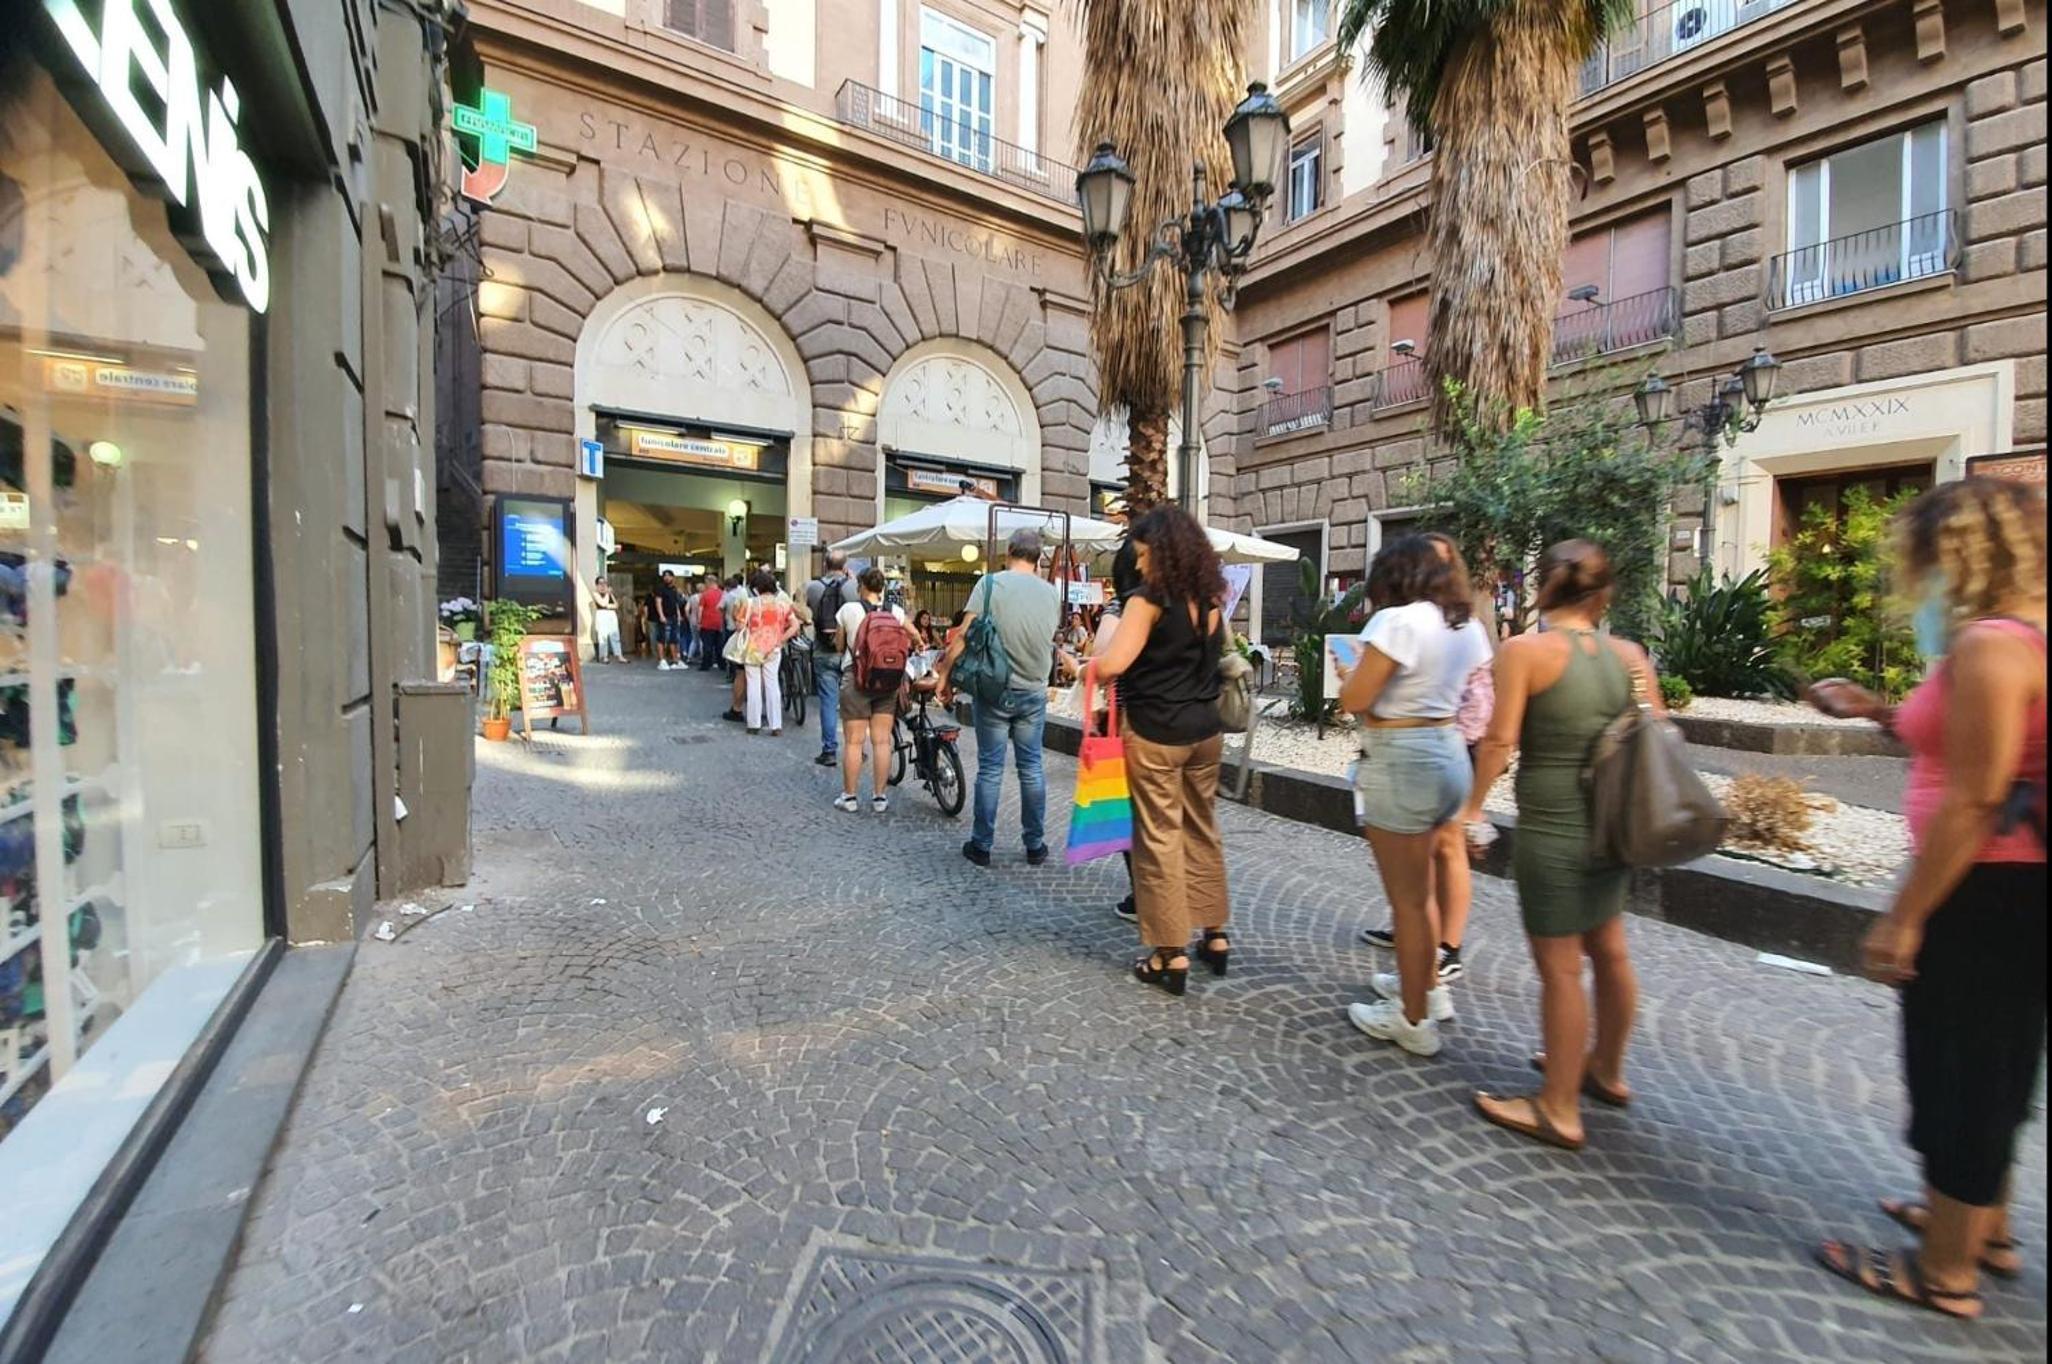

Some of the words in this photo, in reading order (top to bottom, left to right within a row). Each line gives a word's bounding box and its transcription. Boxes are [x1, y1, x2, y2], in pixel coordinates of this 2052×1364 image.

[579, 111, 809, 201] STAZIONE
[884, 208, 1042, 276] FVNICOLARE
[1796, 397, 1910, 427] MCMXXIX
